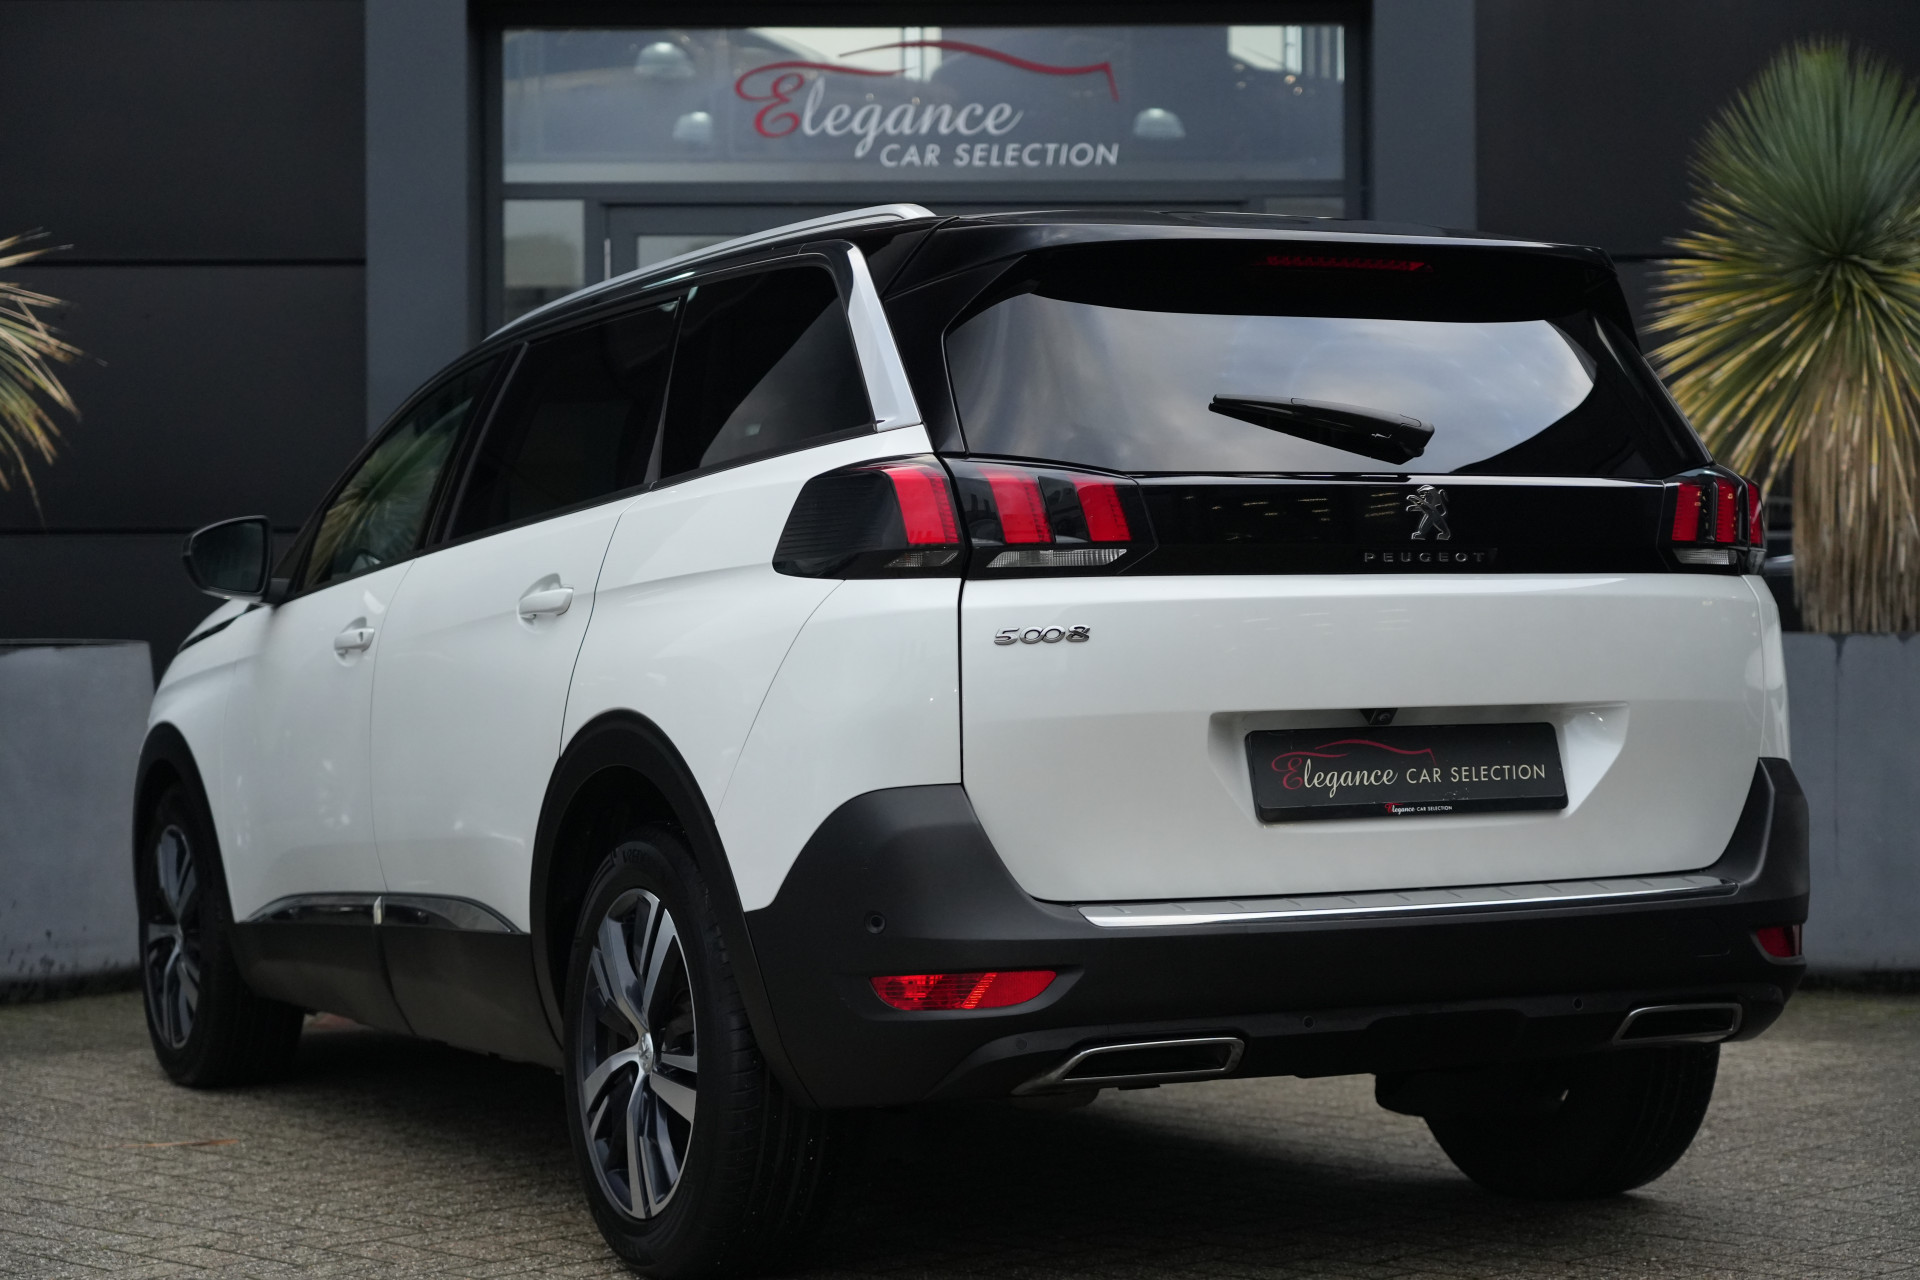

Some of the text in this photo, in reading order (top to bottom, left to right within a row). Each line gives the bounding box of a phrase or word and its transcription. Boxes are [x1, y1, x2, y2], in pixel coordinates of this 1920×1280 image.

[735, 68, 1024, 158] Elegance
[879, 142, 1120, 167] CAR SELECTION
[1364, 552, 1485, 563] PEUGEOT
[993, 624, 1091, 646] 5008
[1271, 755, 1545, 798] Elegance CAR SELECTION
[1384, 803, 1415, 815] Elegance
